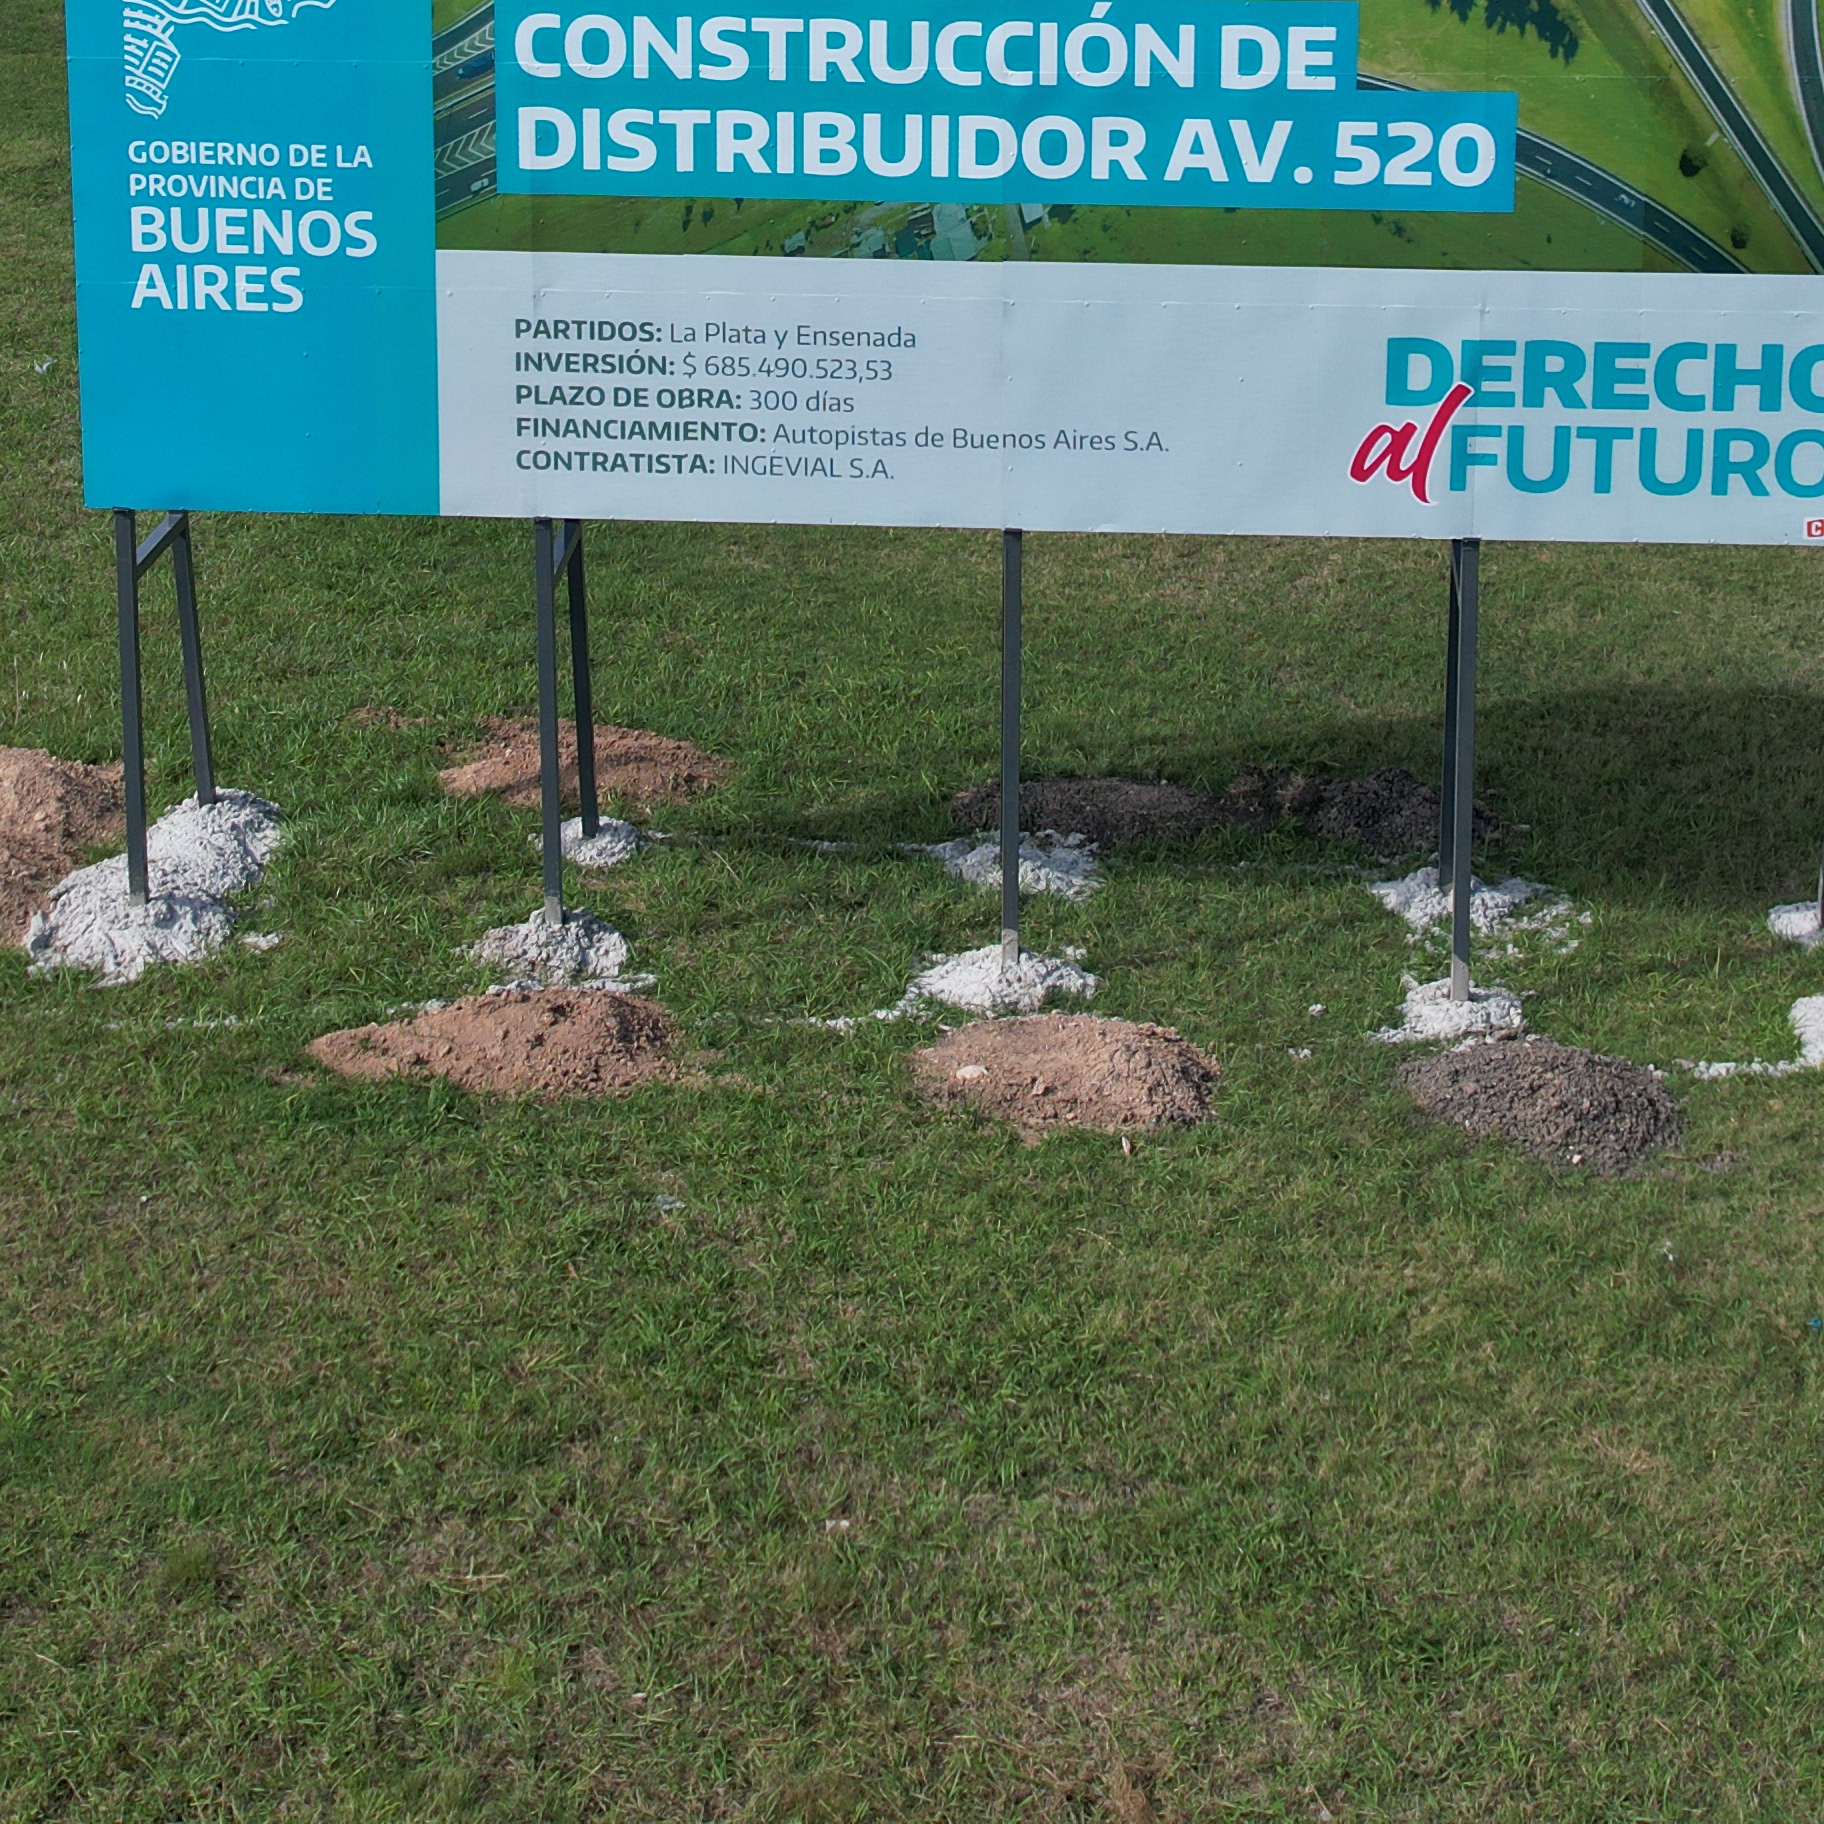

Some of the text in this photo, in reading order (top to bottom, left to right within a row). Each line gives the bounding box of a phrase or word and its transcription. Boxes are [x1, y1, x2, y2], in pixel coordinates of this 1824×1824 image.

[515, 2, 1336, 90] CONSTRUCCIÓN DE
[129, 141, 372, 167] GOBIERNO DE LA
[518, 107, 1495, 187] DISTRIBUIDOR AV. 520
[130, 174, 333, 200] PROVINCIA DE
[131, 206, 377, 257] BUENOS
[131, 264, 303, 312] AIRES
[516, 319, 915, 350] PARTIDOS: La Plata y Ensenada
[516, 349, 892, 383] INVERSIÓN: $ 685.490.523,53
[516, 385, 854, 412] PLAZO DE OBRA: 300 días
[517, 418, 1170, 452] FINANCIAMIENTO: Autopistas de Buenos Aires S.A.
[1350, 383, 1473, 504] al
[516, 450, 893, 479] CONTRATISTA: INGEVIAL S.A.
